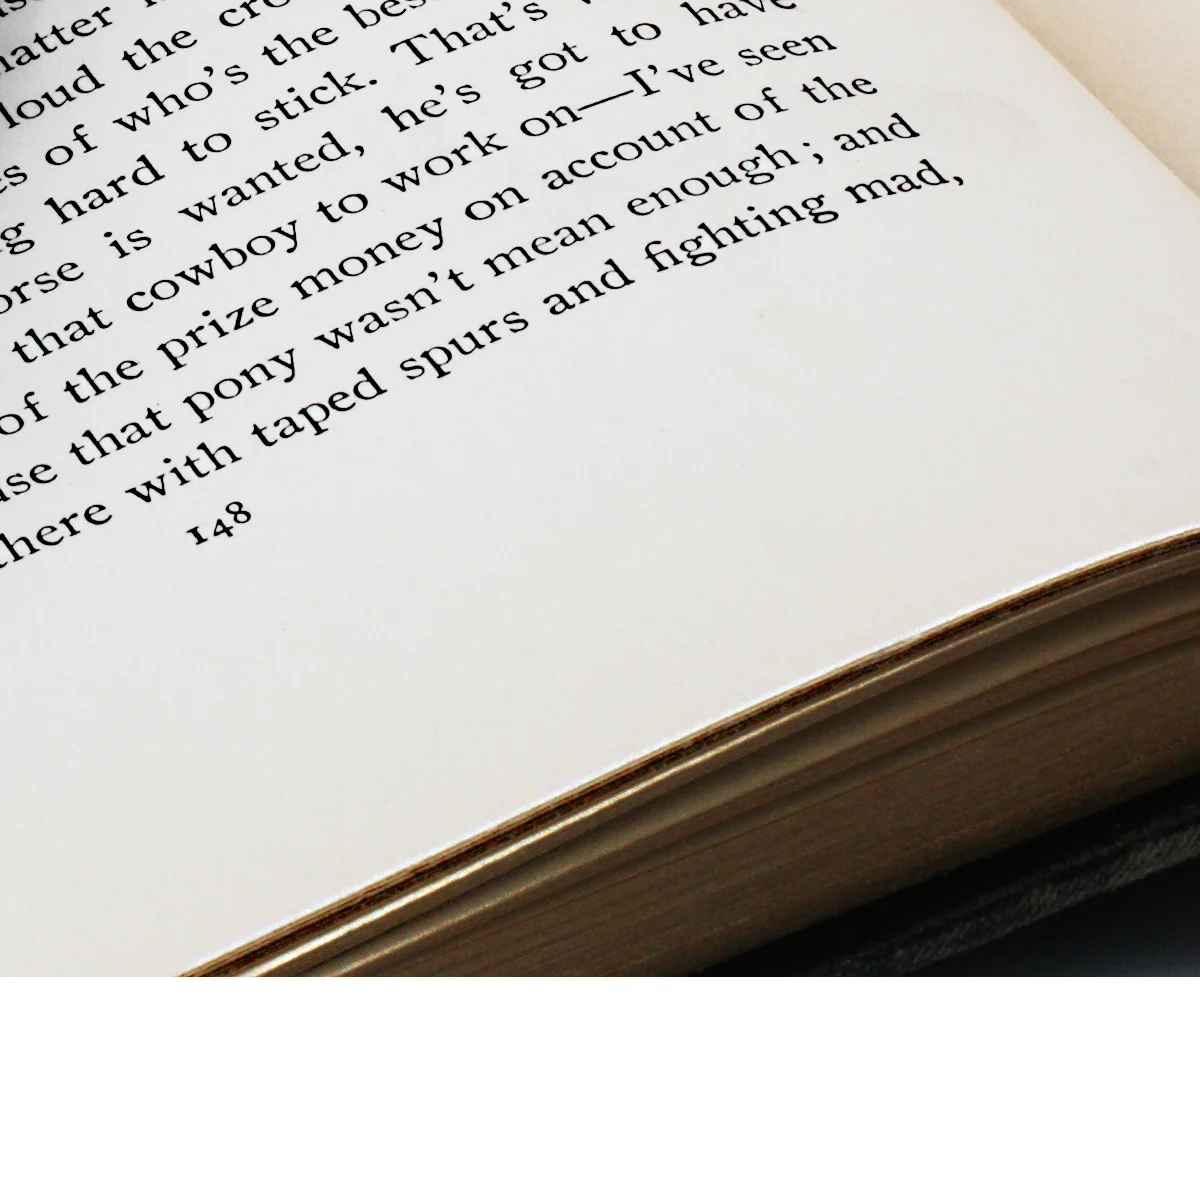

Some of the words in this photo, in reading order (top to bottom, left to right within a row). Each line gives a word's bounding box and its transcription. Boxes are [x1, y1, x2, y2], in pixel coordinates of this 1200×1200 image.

[44, 154, 165, 224] hard
[255, 71, 377, 131] stick.
[127, 220, 297, 312] cowboy
[381, 131, 508, 192] work
[738, 35, 837, 66] seen
[157, 298, 279, 371] prize
[290, 217, 443, 300] money
[541, 112, 721, 190] account
[178, 131, 364, 222] wanted,
[509, 42, 588, 90] got
[183, 348, 295, 424] pony
[833, 112, 920, 151] and
[251, 367, 388, 447] taped
[400, 311, 529, 380] spurs
[645, 194, 839, 272] fighting
[845, 159, 963, 204] mad,
[186, 501, 251, 545] 148
